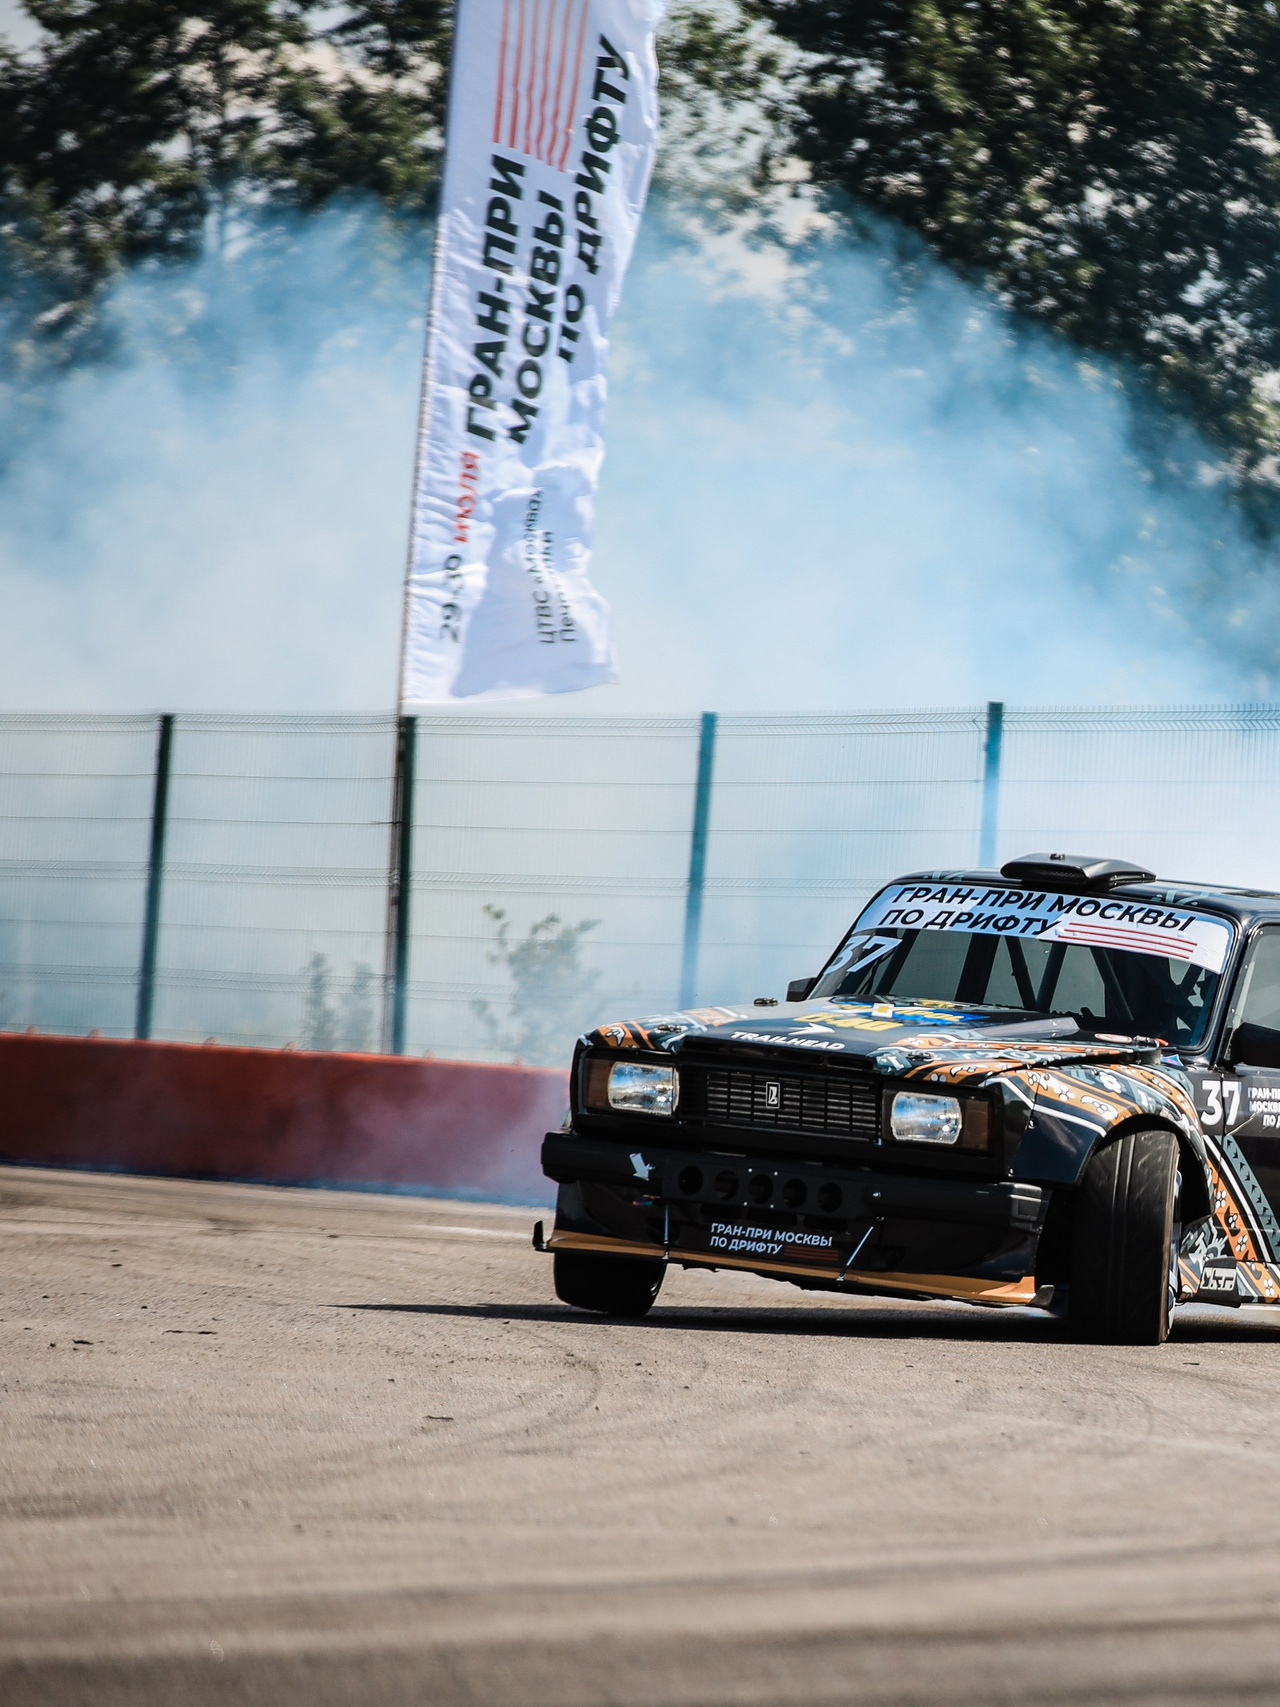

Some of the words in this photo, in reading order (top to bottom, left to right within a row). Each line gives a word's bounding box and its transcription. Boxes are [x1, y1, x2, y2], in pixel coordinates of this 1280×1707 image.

[557, 284, 585, 364] ПО
[575, 33, 630, 275] ДРИФТУ
[466, 154, 527, 441] ГРАН-ПРИ
[507, 190, 565, 444] МОСКВЫ
[453, 451, 479, 544] ИЮЛЯ
[878, 908, 924, 927] ПО
[923, 910, 1062, 936] ДРИФТУ
[892, 886, 1051, 912] ГРАН-ПРИ
[1045, 895, 1197, 932] МОСКВЫ
[730, 1031, 846, 1051] TRAILHEAD
[1200, 1080, 1242, 1126] 37
[1262, 1115, 1276, 1127] ПО
[711, 1223, 772, 1239] ГРАН-ПРИ
[774, 1231, 832, 1246] МОСКВЫ
[711, 1236, 727, 1248] ПО
[728, 1239, 782, 1254] ДРИФТУ
